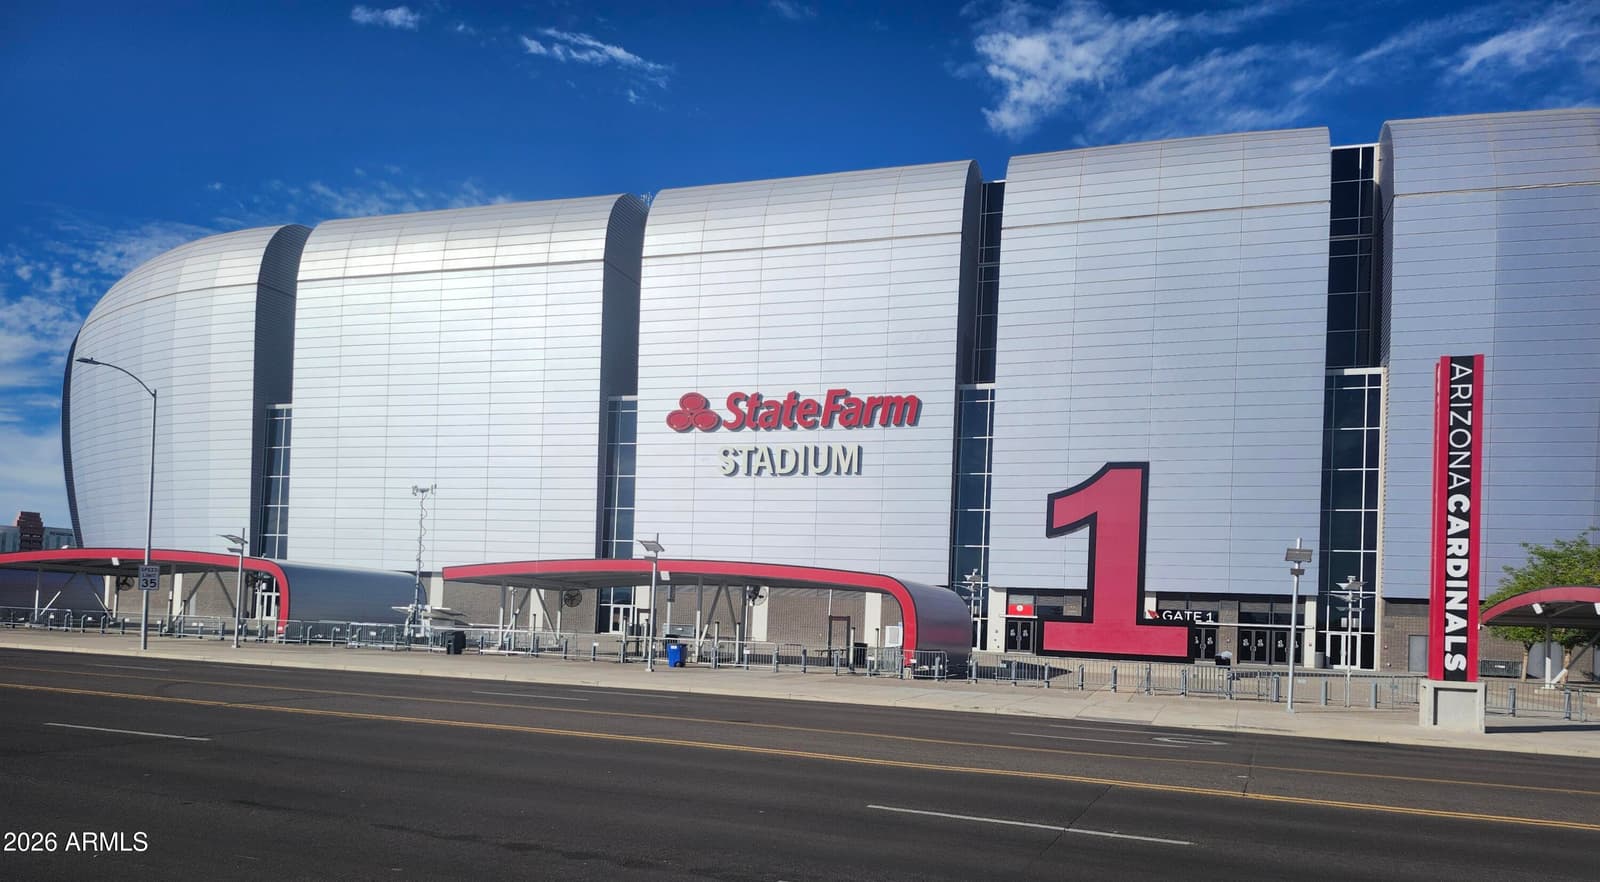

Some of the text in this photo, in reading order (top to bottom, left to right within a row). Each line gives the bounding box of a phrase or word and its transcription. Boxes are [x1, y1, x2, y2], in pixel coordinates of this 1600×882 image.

[718, 443, 863, 476] STADIUM
[1443, 362, 1473, 672] ARIZONA CARDINALS
[1036, 461, 1195, 664] 1
[142, 578, 157, 588] 35
[1162, 610, 1214, 623] GATE 1
